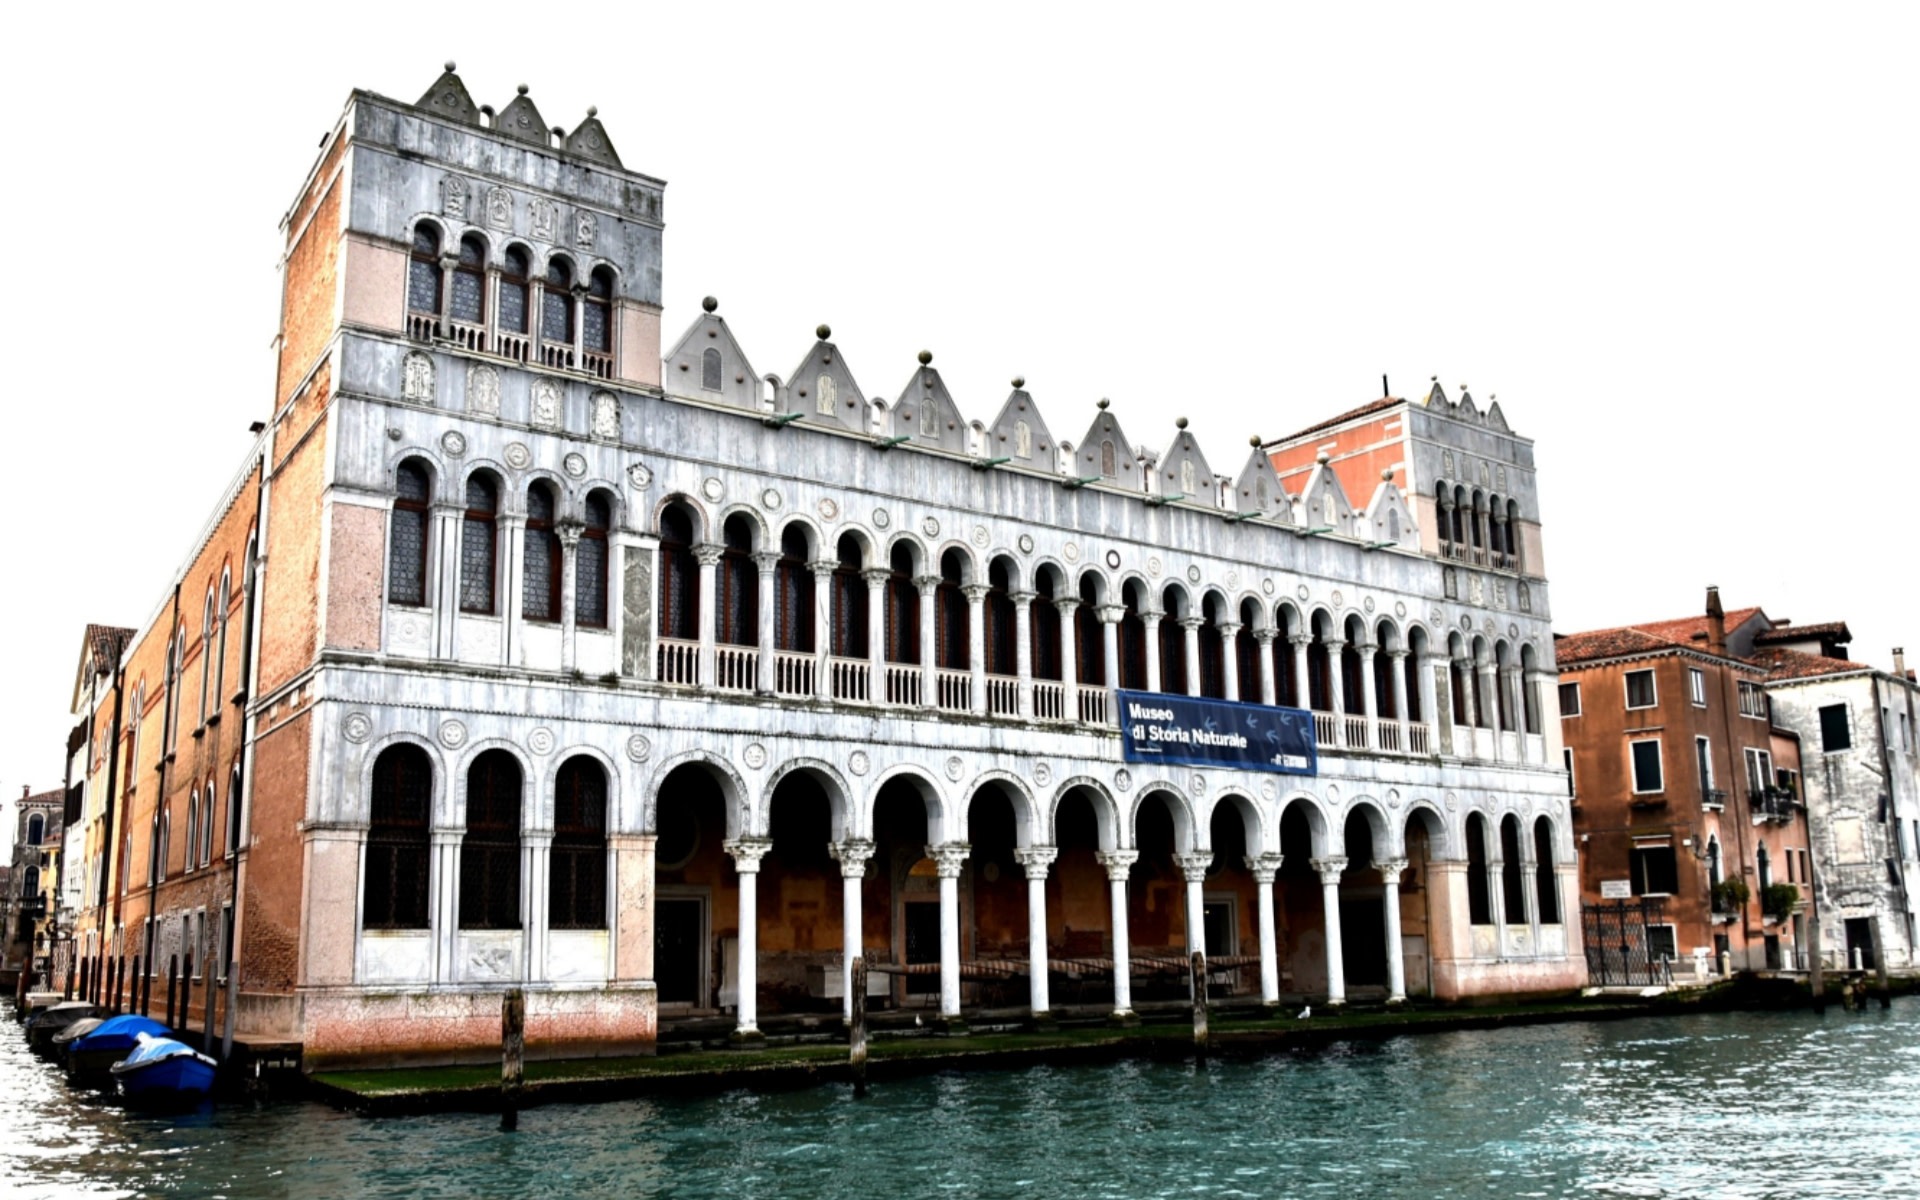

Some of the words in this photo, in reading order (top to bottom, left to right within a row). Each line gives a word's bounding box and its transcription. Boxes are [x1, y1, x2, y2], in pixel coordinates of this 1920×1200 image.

[1129, 703, 1174, 721] Museo
[1132, 724, 1145, 740] di
[1149, 725, 1190, 743] Storia
[1192, 728, 1247, 748] Naturale
